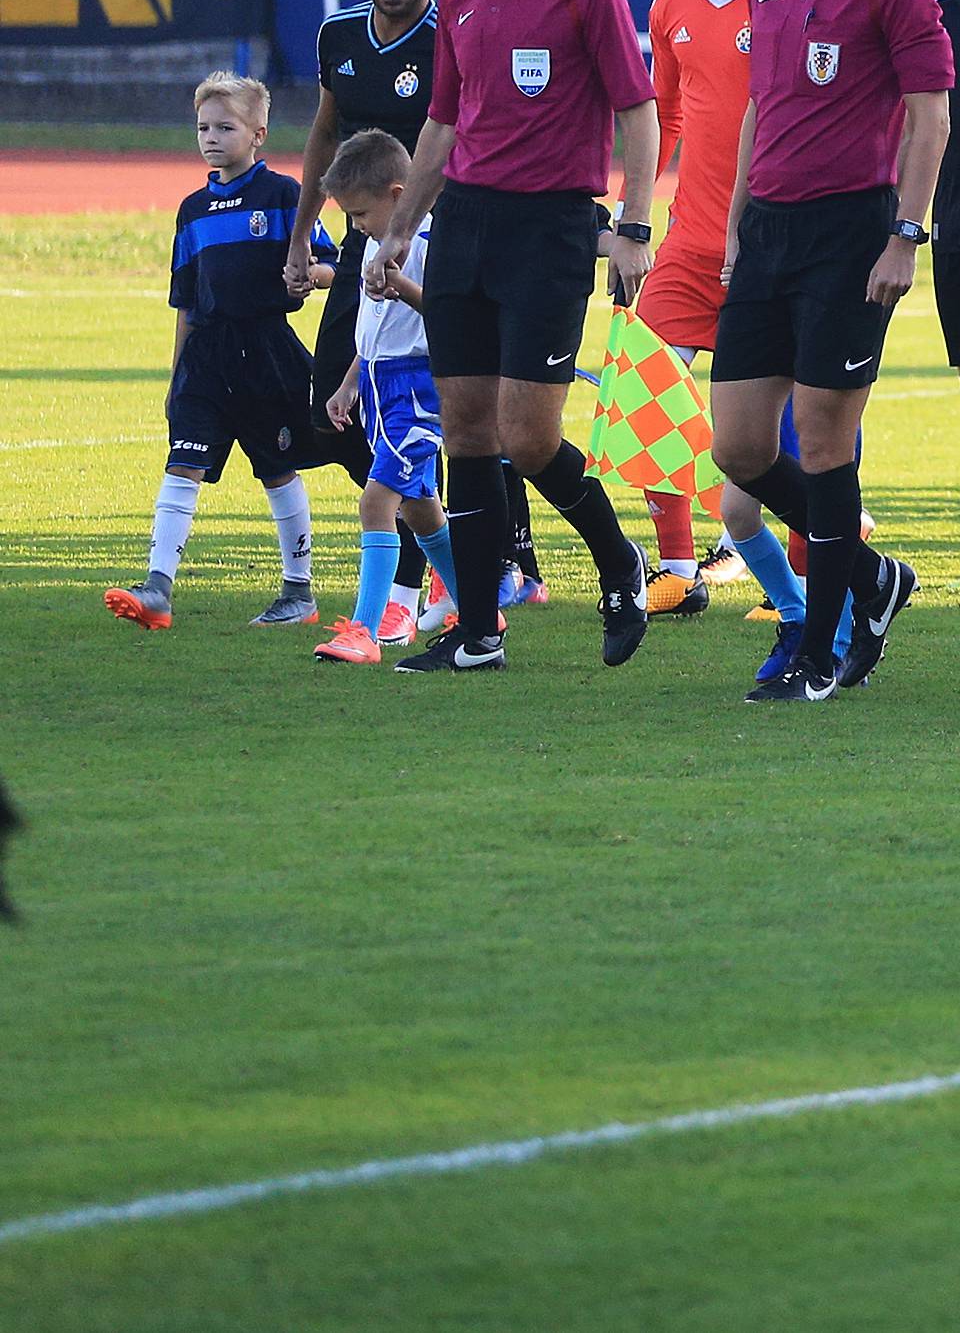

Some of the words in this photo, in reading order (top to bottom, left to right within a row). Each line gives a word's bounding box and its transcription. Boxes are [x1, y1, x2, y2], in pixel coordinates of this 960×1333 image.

[520, 69, 543, 78] FIFA
[208, 197, 243, 212] Zeus
[172, 439, 209, 453] Zeus
